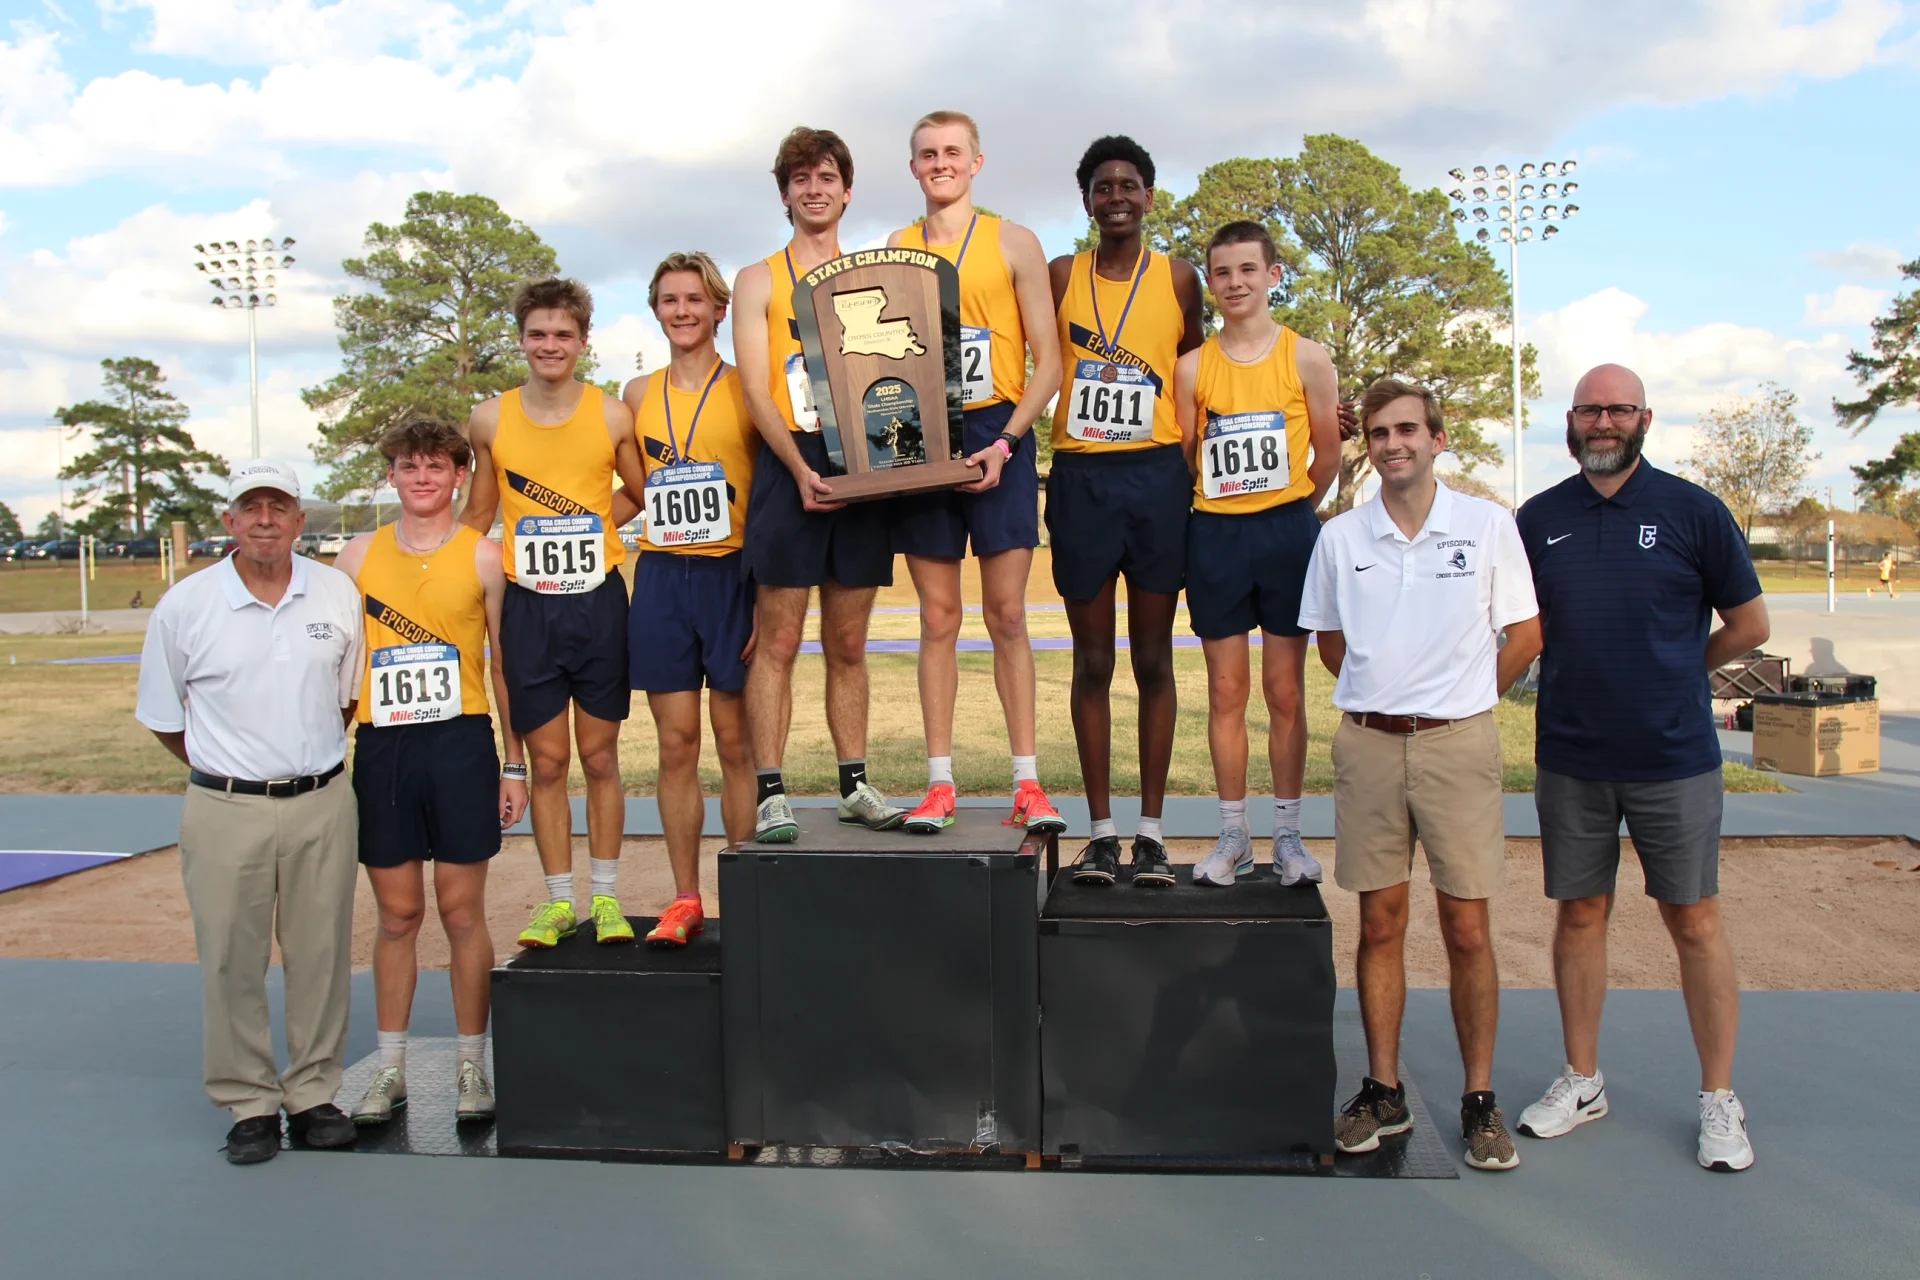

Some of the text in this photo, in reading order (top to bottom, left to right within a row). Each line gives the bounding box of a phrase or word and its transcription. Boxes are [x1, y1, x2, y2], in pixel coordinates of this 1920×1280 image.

[806, 250, 939, 287] STATE CHAMPION
[848, 329, 905, 341] CROSS COUNTRY
[875, 384, 902, 397] 2025
[1077, 385, 1142, 426] 1611
[1252, 414, 1275, 422] COUNTRY
[1221, 421, 1270, 433] CHAMPIONSHIPS
[1082, 426, 1132, 442] MileSplit
[1210, 435, 1279, 478] 1618
[692, 465, 714, 473] COUNTRY
[665, 472, 711, 483] CHAMPIONSHIPS
[1220, 477, 1268, 494] MileSplit
[652, 486, 721, 527] 1609
[554, 518, 571, 526] CROSS
[571, 517, 593, 525] COUNTRY
[540, 524, 590, 534] CHAMPIONSHIPS
[663, 528, 710, 542] MileSplit
[1436, 540, 1476, 550] EPISCOPAL
[525, 539, 595, 576] 1615
[536, 580, 585, 593] MileSplit
[406, 646, 424, 654] CROSS
[424, 645, 447, 653] COUNTRY
[393, 652, 444, 663] CHAMPIONSHIPS
[379, 666, 452, 706] 1613
[389, 708, 441, 722] MileSplit
